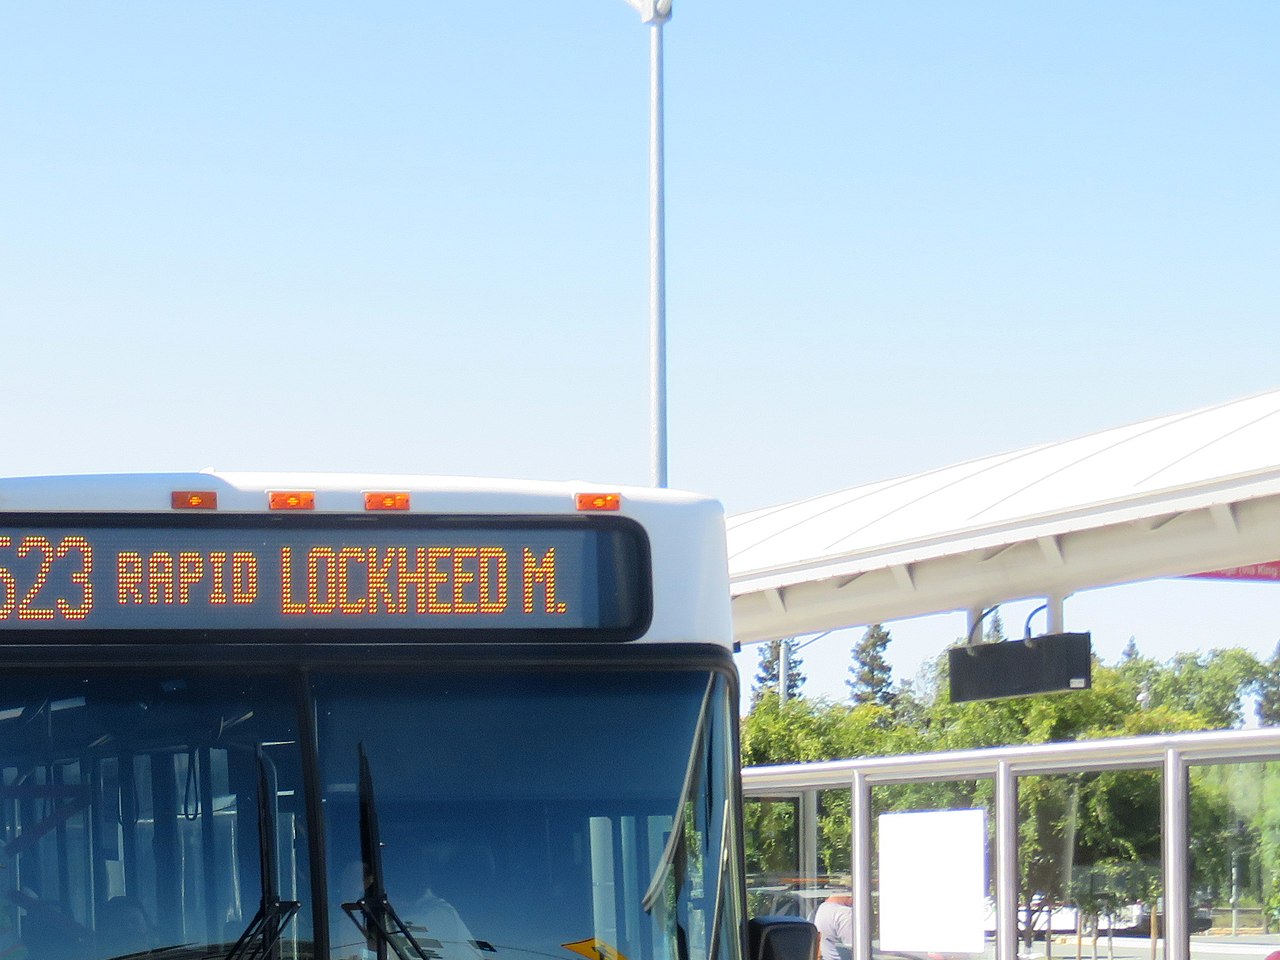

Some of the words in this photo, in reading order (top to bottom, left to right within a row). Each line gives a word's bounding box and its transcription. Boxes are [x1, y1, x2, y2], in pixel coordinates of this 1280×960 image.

[118, 551, 257, 604] RAPID
[281, 546, 508, 614] LOCKHEED
[523, 546, 567, 614] M.
